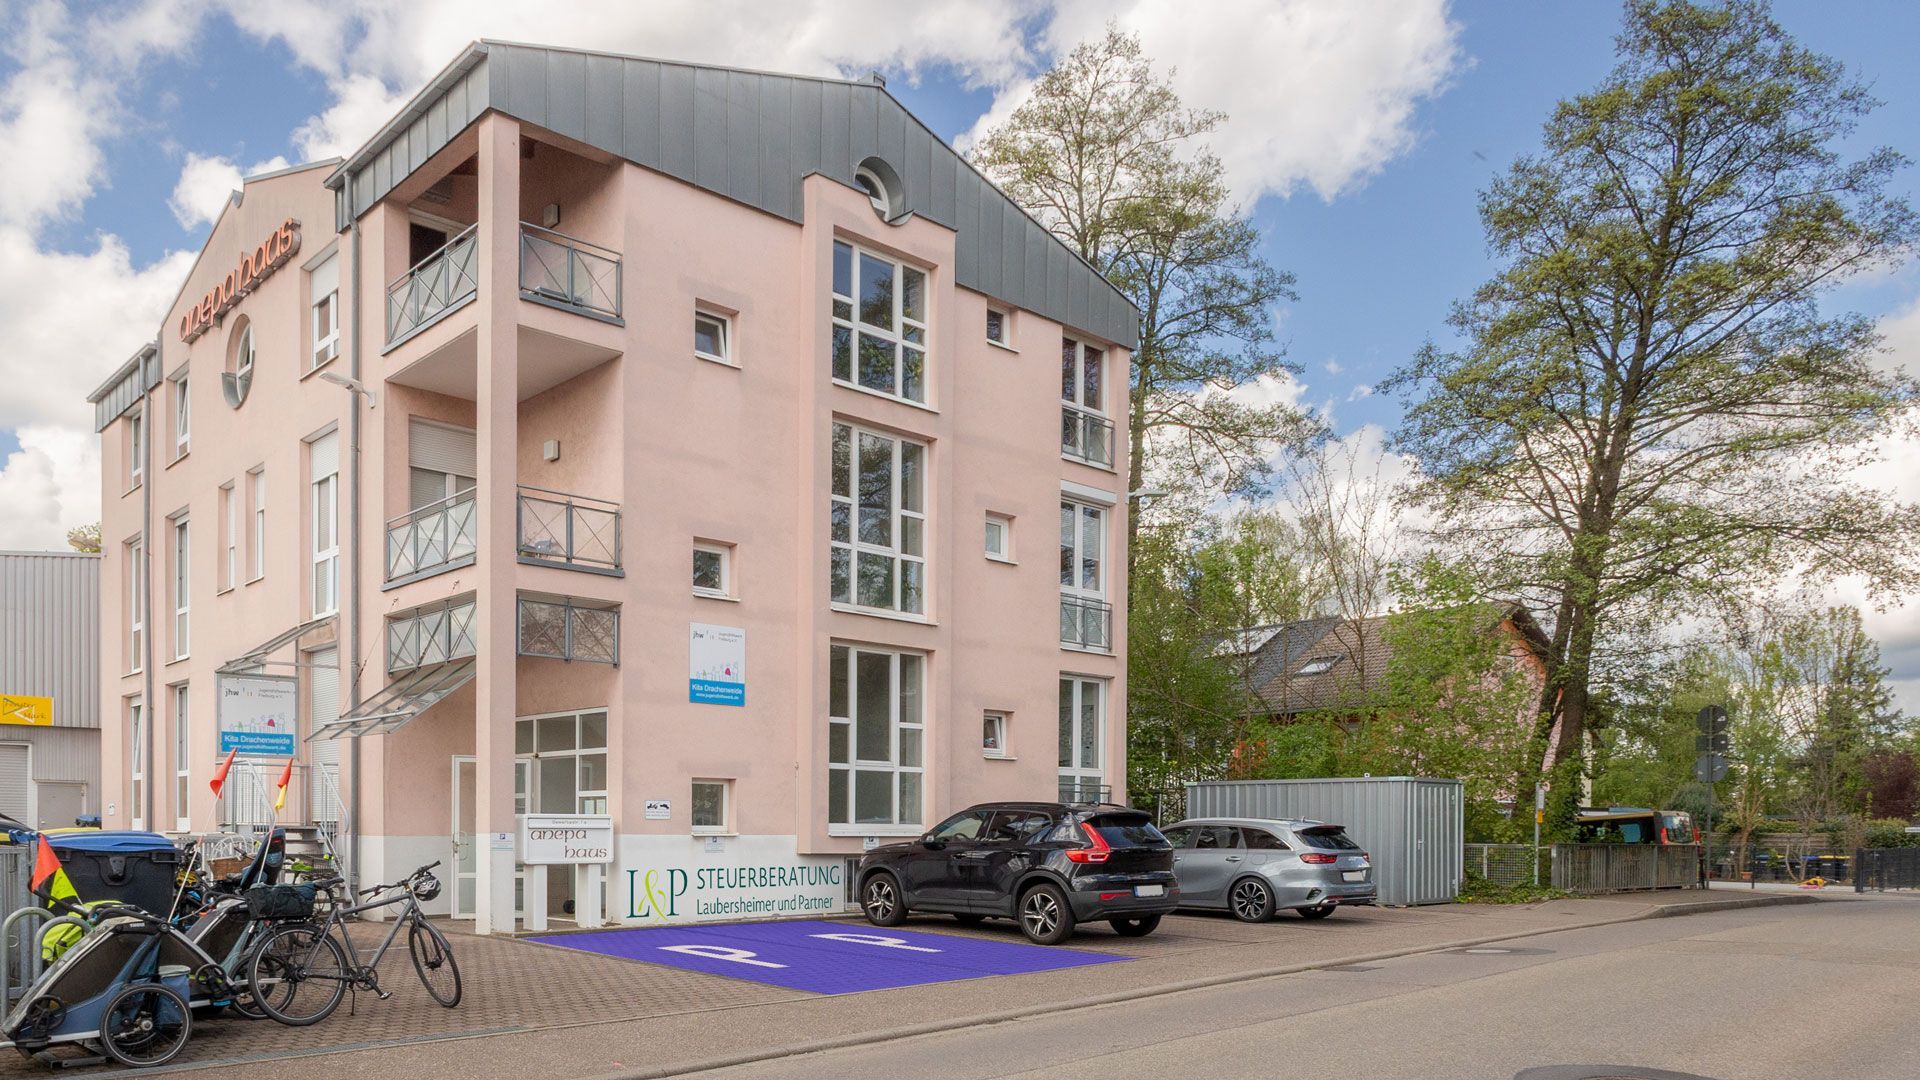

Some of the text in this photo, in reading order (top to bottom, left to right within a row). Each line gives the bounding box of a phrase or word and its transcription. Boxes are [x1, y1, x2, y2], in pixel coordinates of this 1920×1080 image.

[225, 687, 239, 697] jhw
[692, 683, 703, 691] Kita
[224, 734, 239, 743] Kita
[530, 829, 587, 843] anepa
[564, 845, 607, 858] haus
[696, 865, 841, 890] STEUERBERATUNG
[626, 868, 688, 921] L&P
[696, 894, 834, 915] Laubersheimer und Partner
